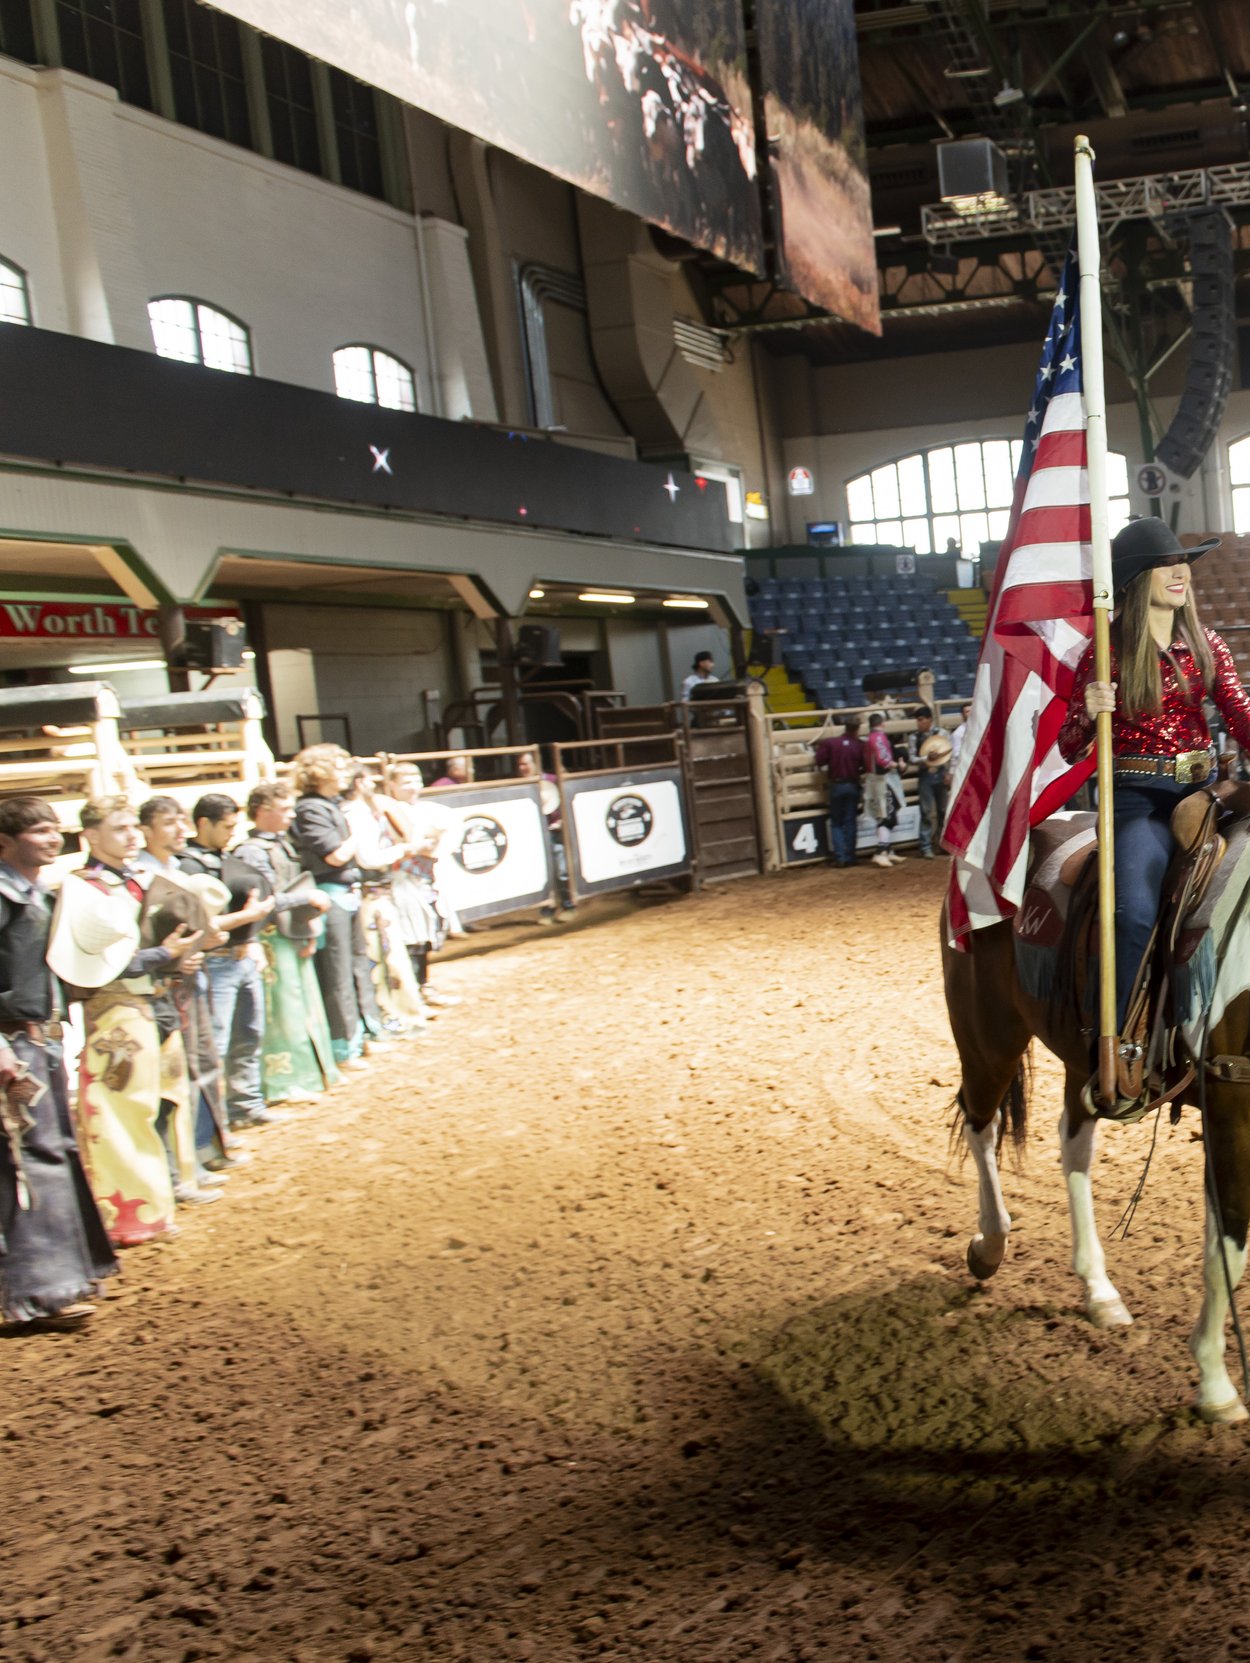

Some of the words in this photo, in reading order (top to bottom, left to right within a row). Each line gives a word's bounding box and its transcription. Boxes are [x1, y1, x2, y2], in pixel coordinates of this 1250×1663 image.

[2, 604, 117, 635] Worth
[119, 607, 161, 635] Te
[792, 822, 819, 854] 4
